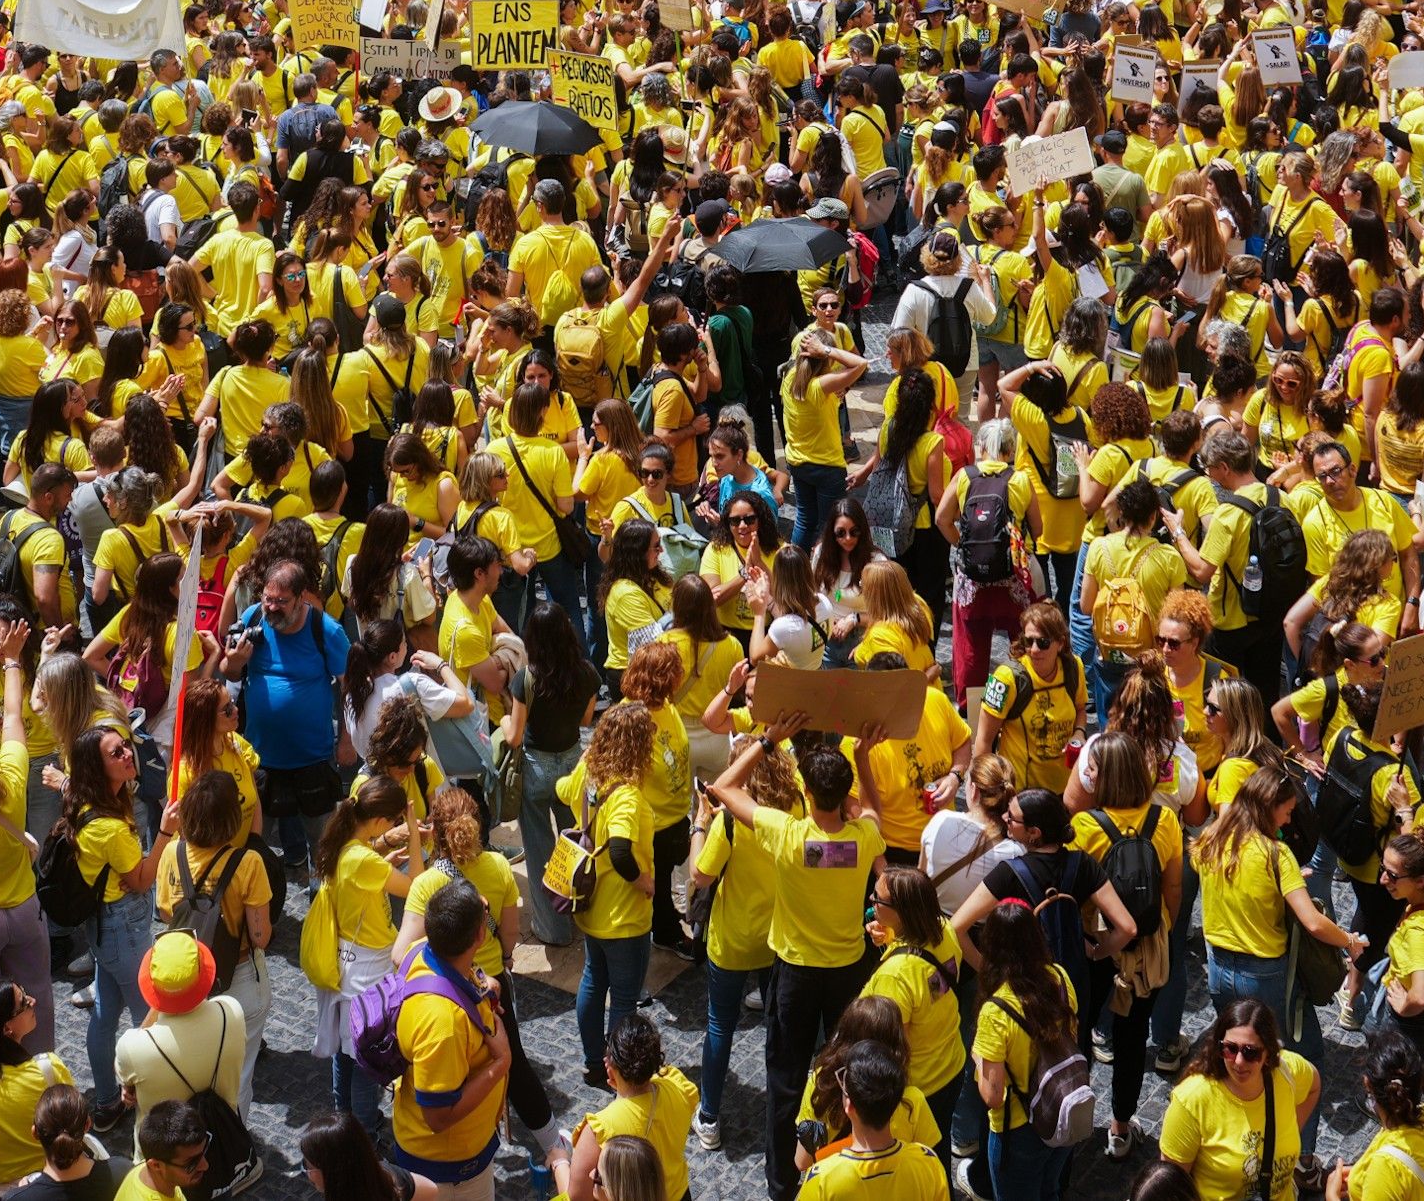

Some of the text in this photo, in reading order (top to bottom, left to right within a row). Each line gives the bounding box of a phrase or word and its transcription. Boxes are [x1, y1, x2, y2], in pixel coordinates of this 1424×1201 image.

[299, 10, 354, 27] EDUCACIÓ
[493, 3, 531, 23] ENS
[300, 29, 355, 44] QUALITAT
[477, 27, 556, 65] PLANTEM
[445, 49, 455, 59] DE
[1120, 77, 1150, 89] INVERSIÓ
[1064, 147, 1076, 156] DE
[1394, 658, 1411, 672] NO
[990, 678, 1005, 693] JO
